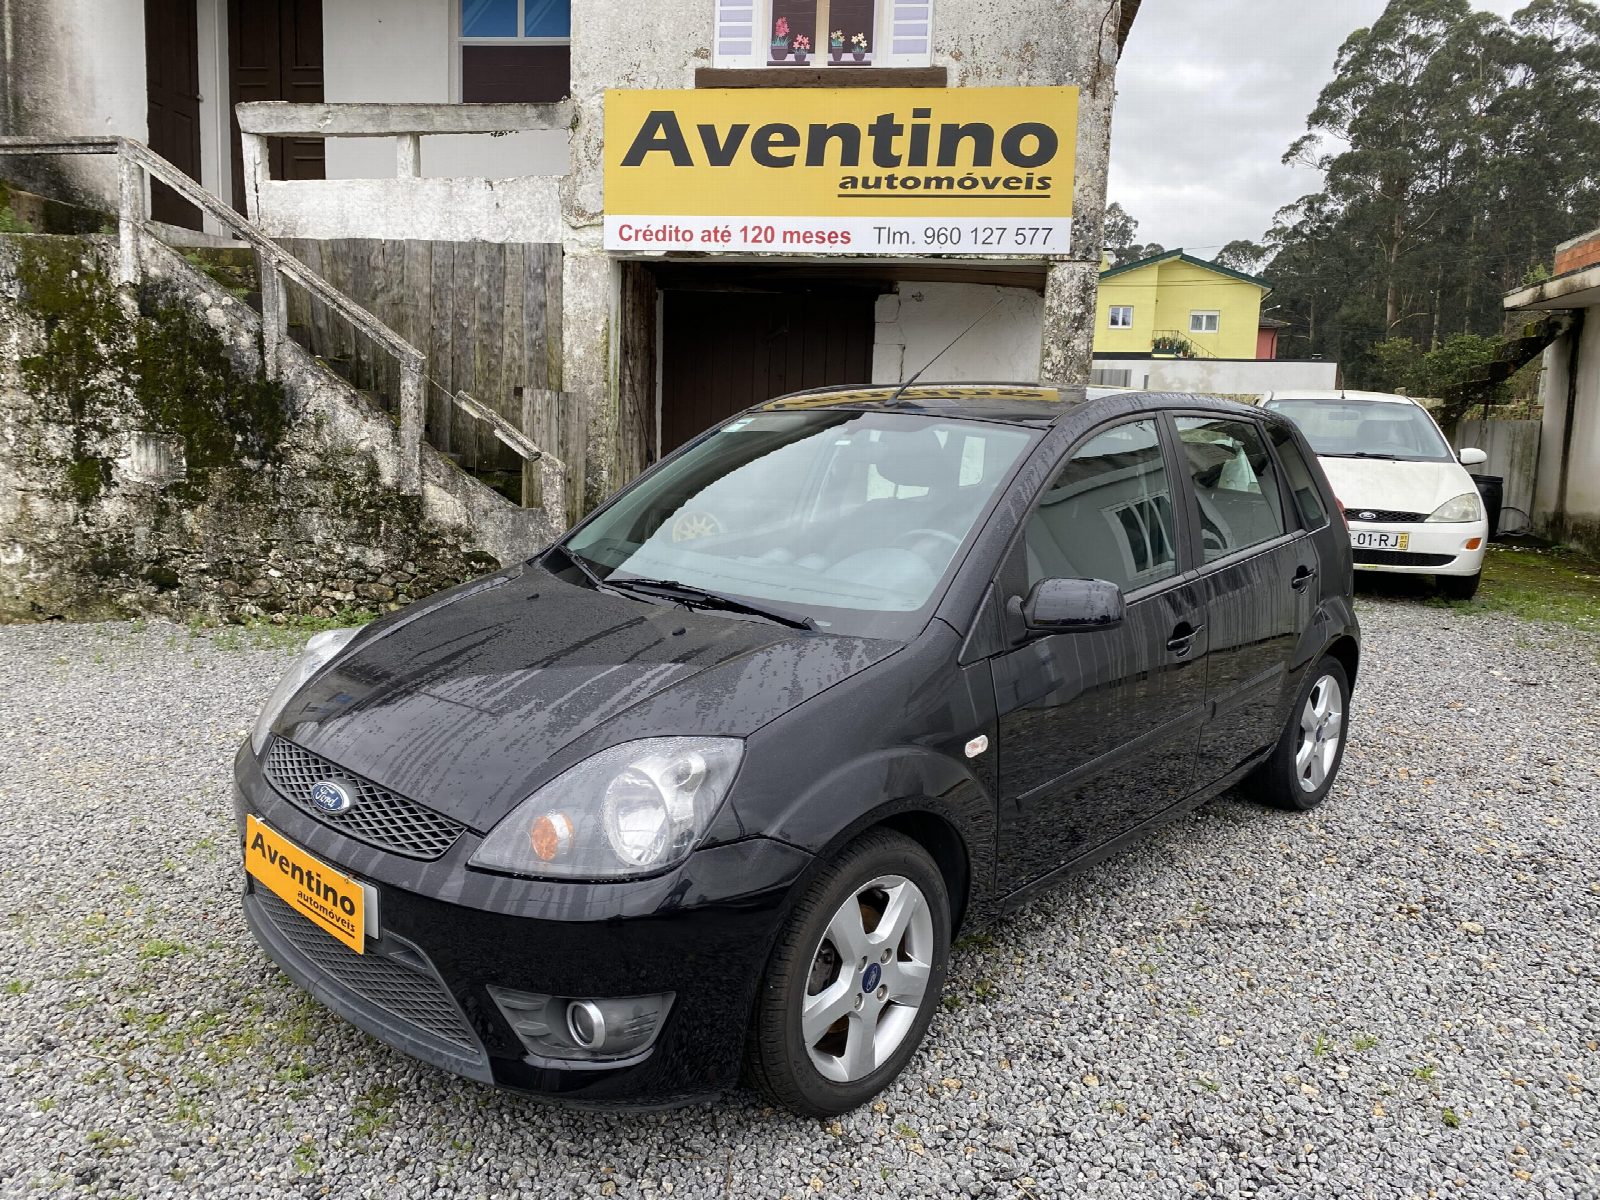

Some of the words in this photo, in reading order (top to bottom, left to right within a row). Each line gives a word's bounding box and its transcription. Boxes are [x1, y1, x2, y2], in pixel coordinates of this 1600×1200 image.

[619, 107, 1059, 169] Aventino
[838, 172, 1052, 191] automóveis
[618, 223, 694, 243] Crédito
[701, 226, 731, 244] até
[740, 226, 776, 244] 120
[782, 230, 851, 245] meses
[873, 226, 917, 245] Tlm.
[924, 226, 962, 246] 960
[969, 226, 1008, 245] 127
[1014, 227, 1054, 246] 577
[1349, 532, 1399, 547] -01-RJ
[315, 786, 338, 807] Ford
[251, 832, 355, 916] Aventino
[298, 891, 355, 932] automóveis
